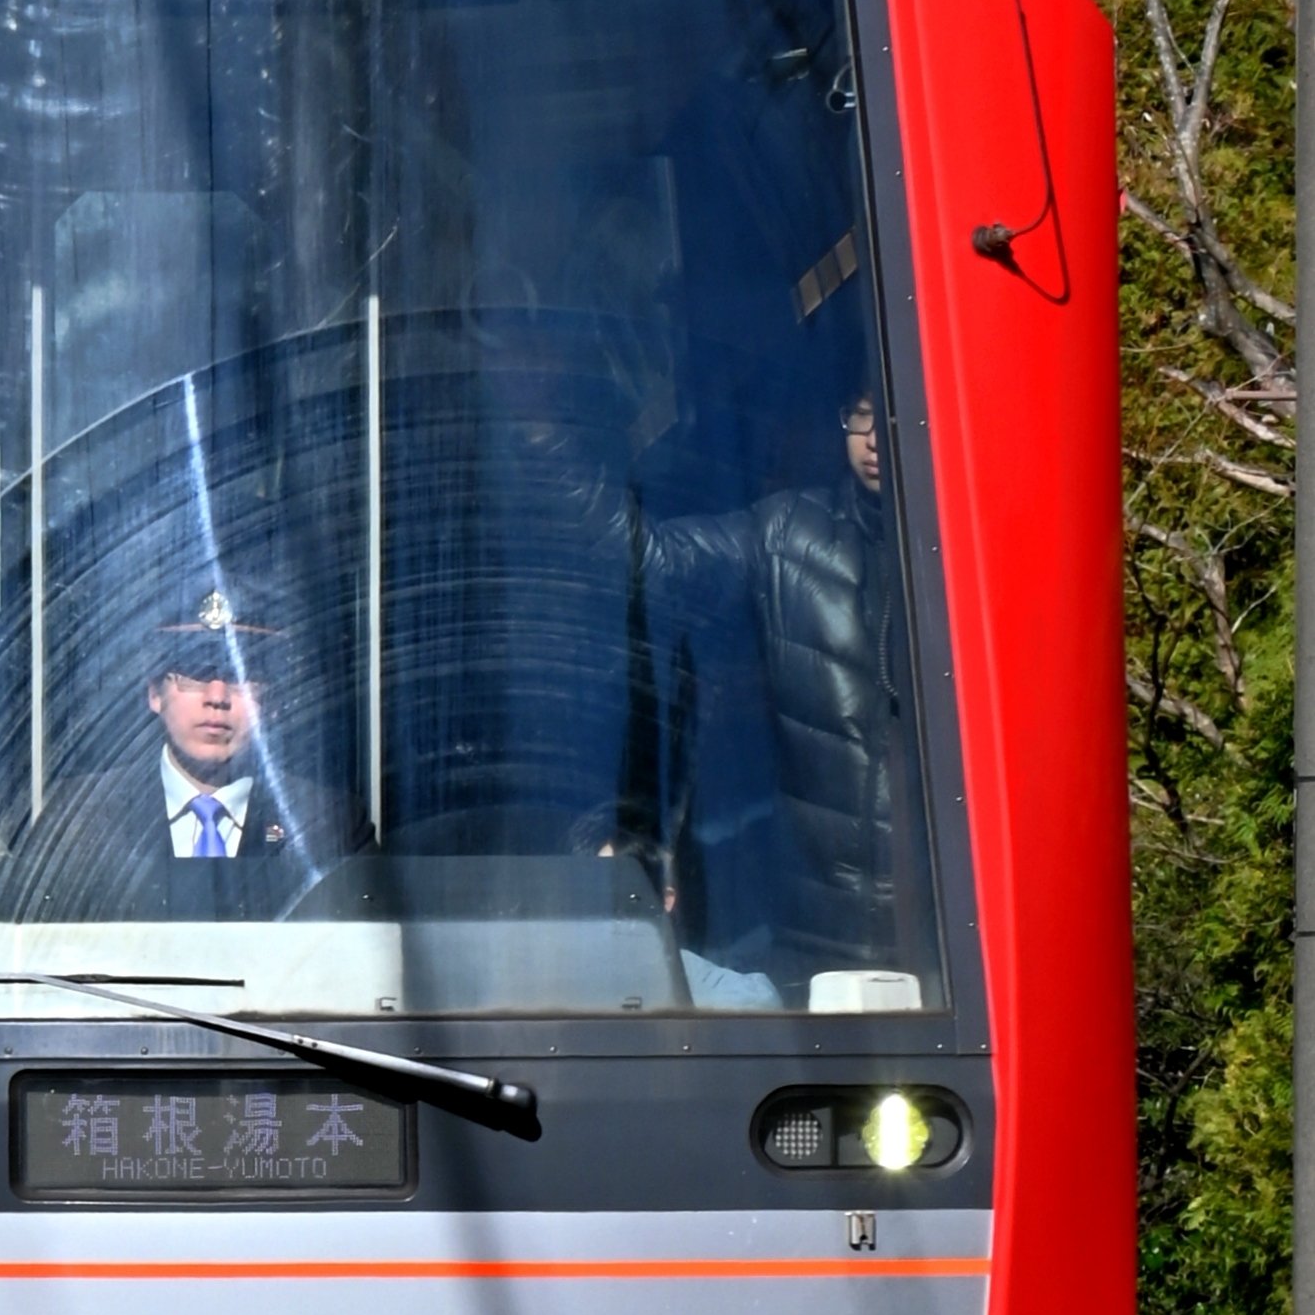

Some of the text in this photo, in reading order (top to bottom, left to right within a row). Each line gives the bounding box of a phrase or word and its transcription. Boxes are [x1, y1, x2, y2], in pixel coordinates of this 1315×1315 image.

[62, 1093, 364, 1155] 箱根湯本
[103, 1157, 327, 1180] HAKONE-YUMOTO
